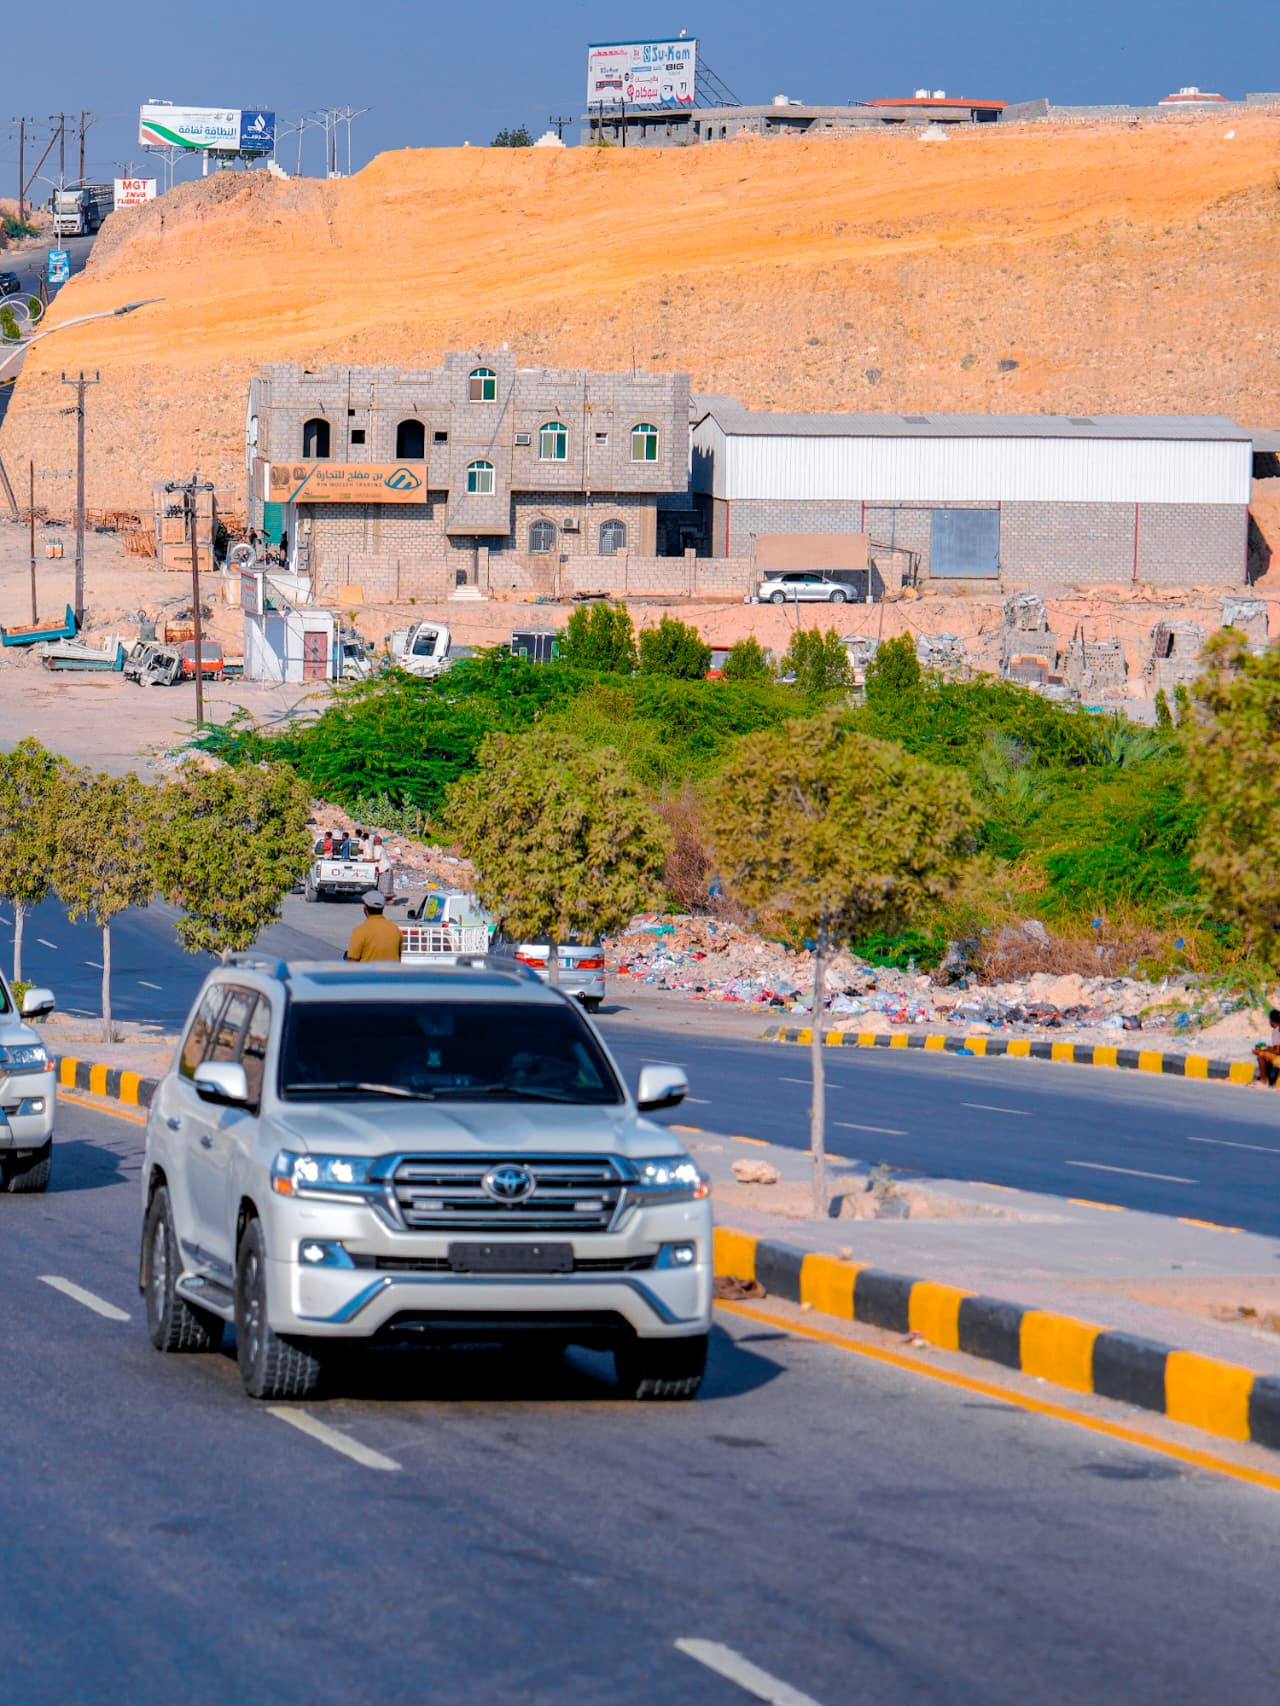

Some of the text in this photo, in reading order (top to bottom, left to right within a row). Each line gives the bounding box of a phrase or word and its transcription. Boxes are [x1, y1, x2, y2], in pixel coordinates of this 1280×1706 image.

[652, 46, 690, 62] Su-Kam
[666, 63, 684, 71] BIG
[635, 86, 658, 100] سوكام
[178, 126, 203, 135] ثقافة
[205, 127, 237, 136] النظافة
[122, 180, 147, 190] MGT
[316, 470, 383, 482] بن مفلح للتجارة
